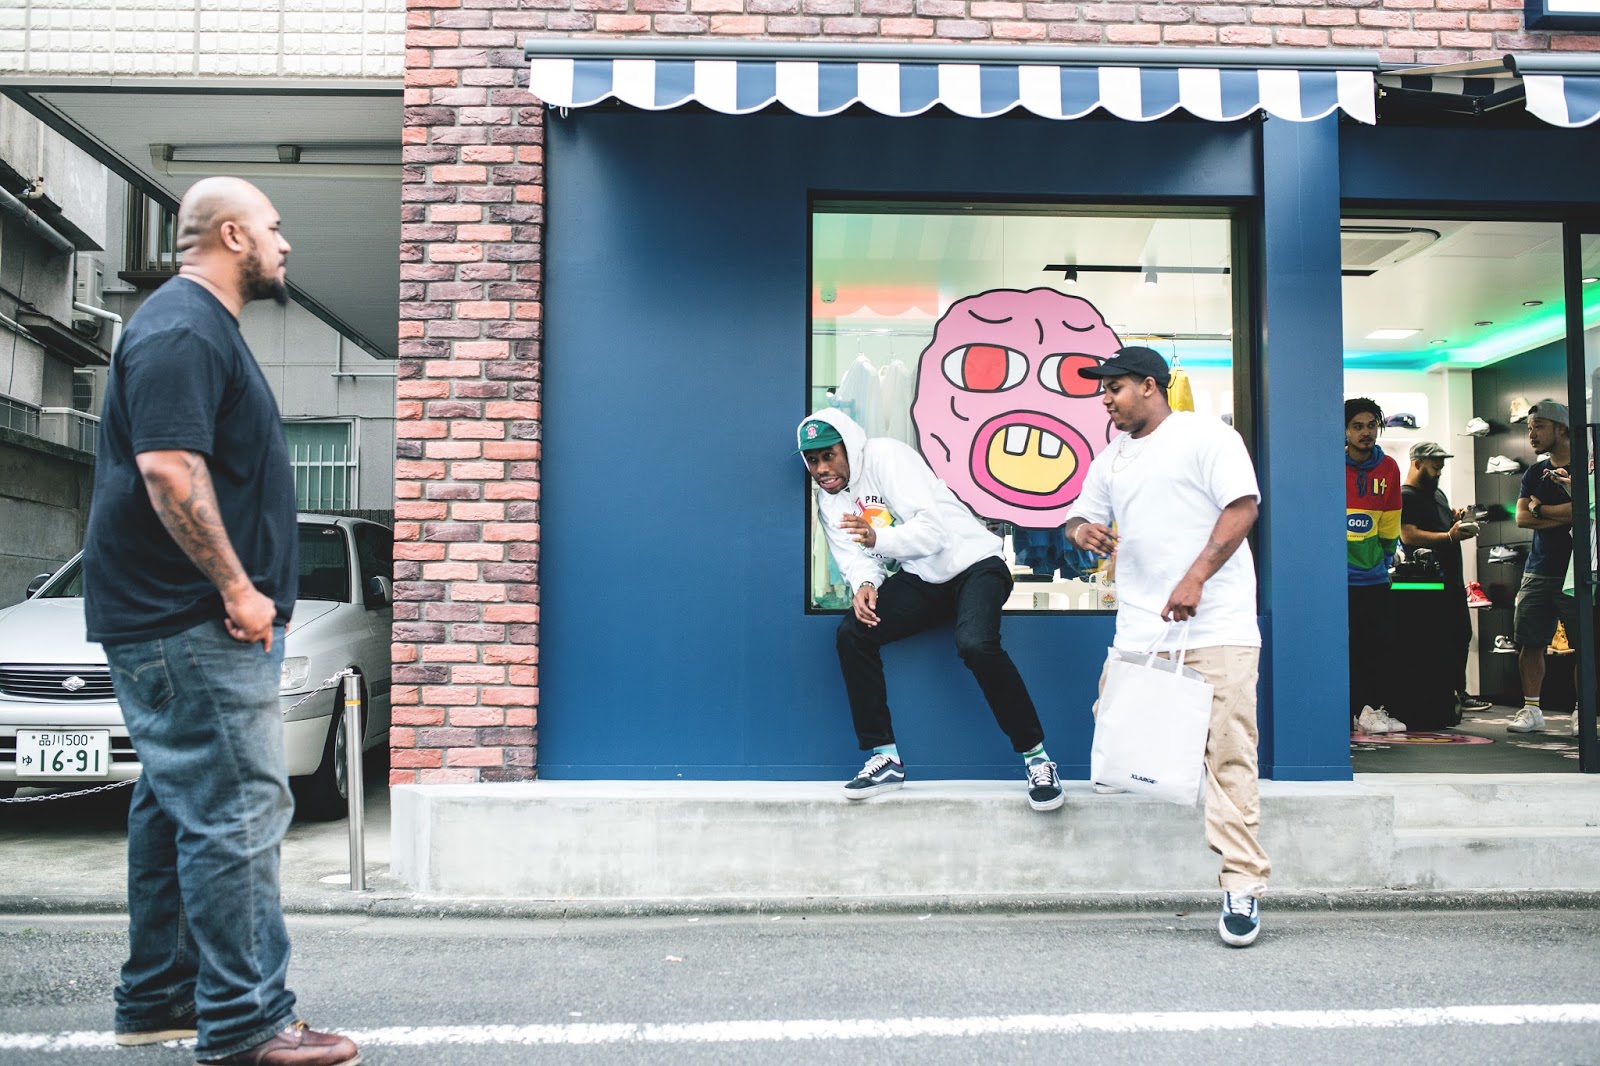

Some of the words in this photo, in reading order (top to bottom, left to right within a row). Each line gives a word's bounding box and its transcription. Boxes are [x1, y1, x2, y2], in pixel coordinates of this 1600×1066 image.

[1347, 518, 1370, 528] GOLF
[22, 754, 33, 766] ゆ
[40, 749, 99, 772] 16-91
